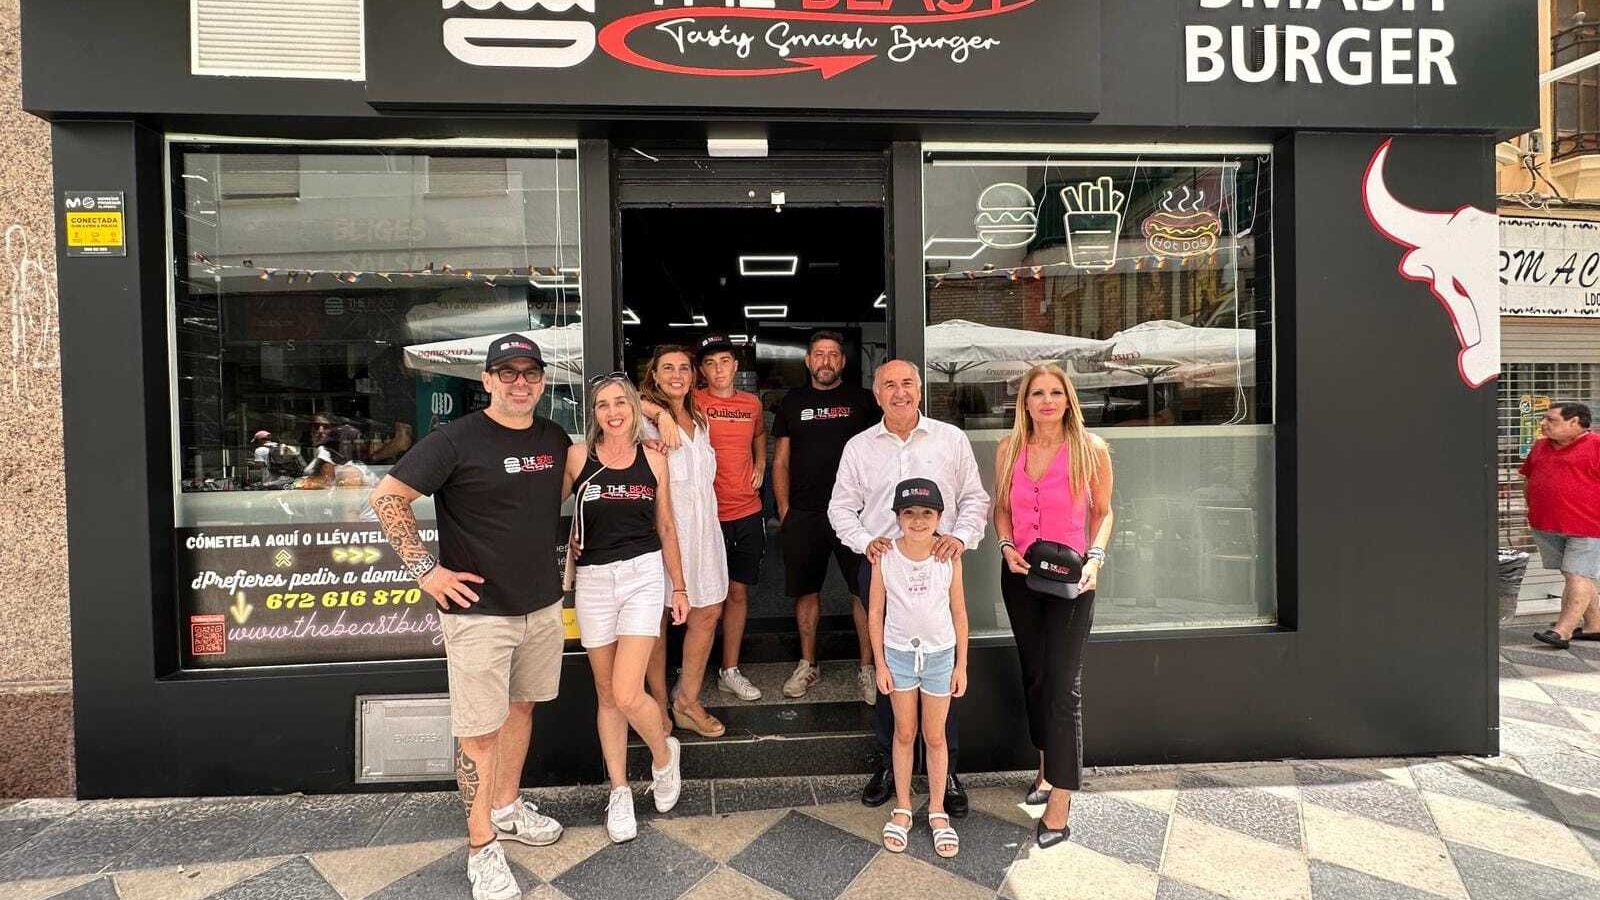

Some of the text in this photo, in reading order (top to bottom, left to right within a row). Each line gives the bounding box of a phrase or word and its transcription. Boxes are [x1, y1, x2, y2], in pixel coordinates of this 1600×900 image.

[655, 18, 1000, 63] Tasty Smash Burger
[1185, 24, 1458, 86] BURGER
[606, 485, 626, 493] THE
[186, 533, 260, 549] CÓMETELA
[265, 530, 299, 547] AQUÍ
[302, 533, 312, 545] O
[288, 566, 339, 591] pedir
[343, 570, 358, 584] a
[266, 588, 422, 609] 672 616 870
